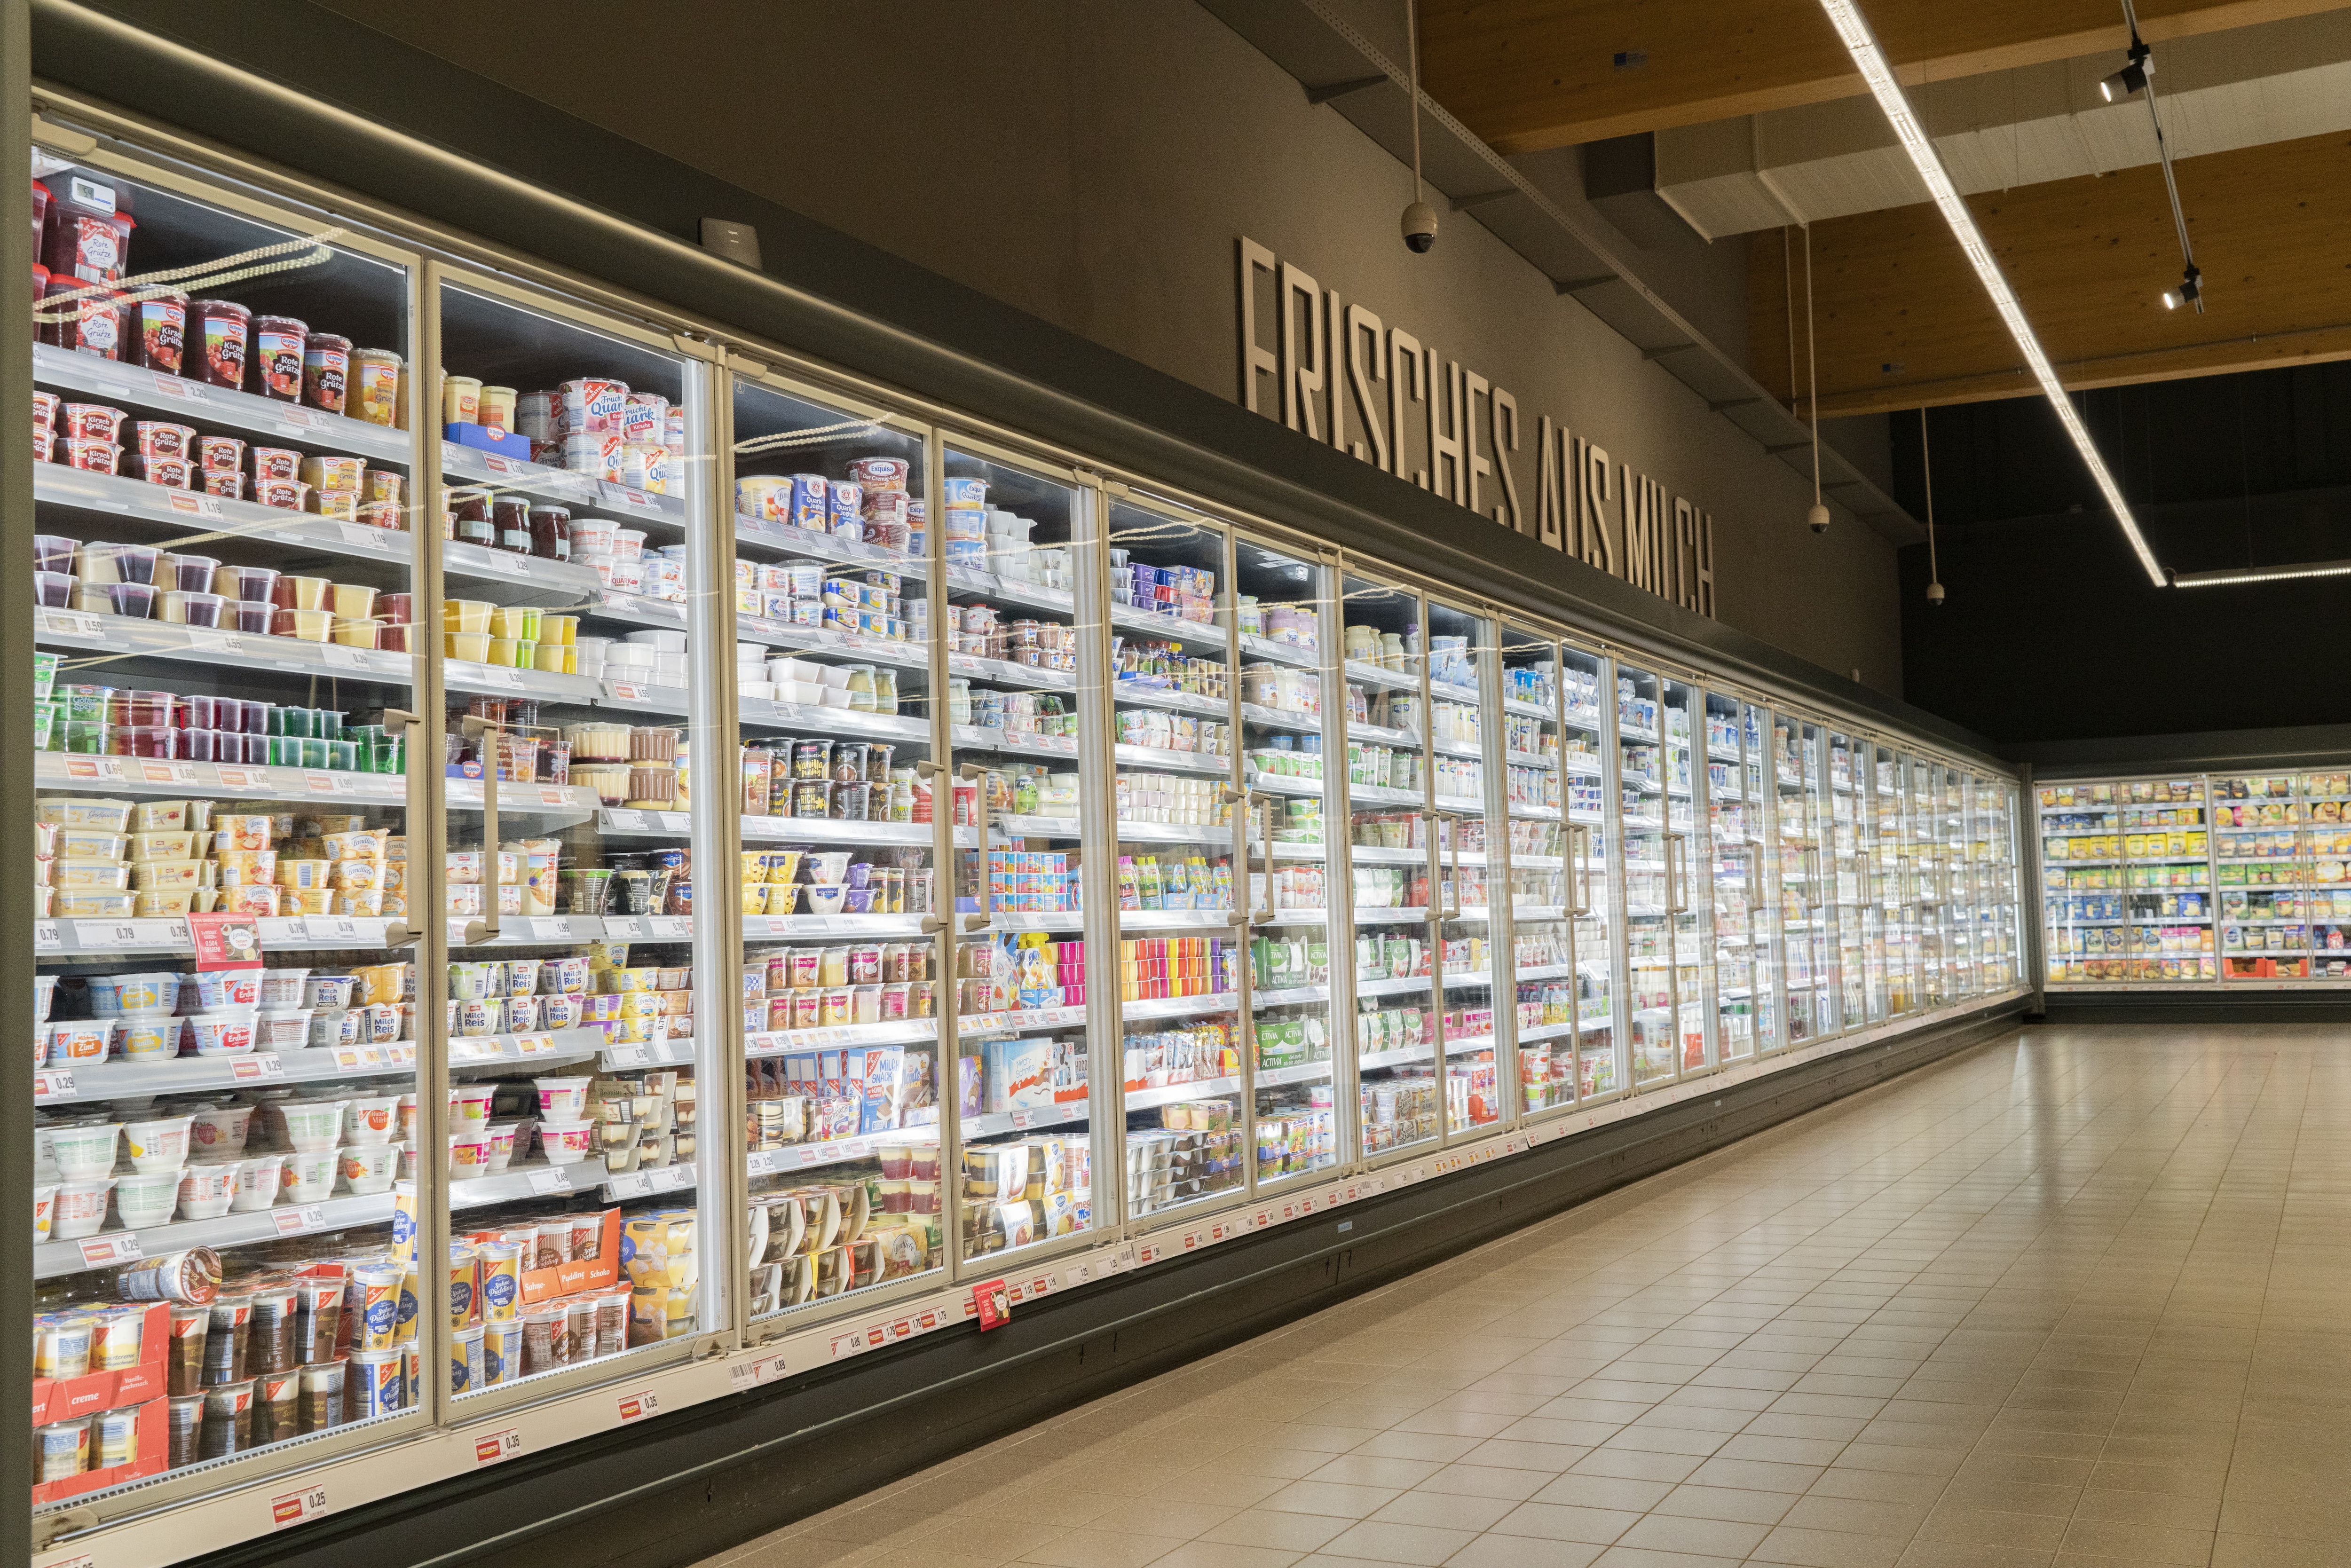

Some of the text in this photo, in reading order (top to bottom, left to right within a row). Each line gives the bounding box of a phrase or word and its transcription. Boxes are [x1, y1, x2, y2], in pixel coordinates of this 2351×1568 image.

[162, 326, 183, 340] Kirsch
[160, 335, 183, 349] Grütze
[224, 342, 245, 353] Kirsch
[222, 350, 245, 362] Grütze
[281, 356, 298, 366] Rote
[275, 363, 300, 374] Grütze
[326, 372, 342, 382] Rote
[320, 379, 345, 390] Grütze
[190, 387, 206, 399] 2.29
[601, 395, 622, 404] Frucht
[1243, 236, 1522, 533] FRISCHES
[1539, 416, 1613, 574] AUS
[88, 416, 110, 425] Kirsch
[86, 422, 110, 432] Grütze
[160, 432, 175, 441] Rote
[155, 439, 179, 448] Grütze
[89, 450, 110, 459] Kirsch
[213, 453, 235, 462] Grütze
[87, 456, 110, 465] Grütze
[271, 464, 292, 473] Grütze
[511, 463, 523, 474] 1.19
[162, 472, 183, 481] Grütze
[272, 494, 295, 502] Grütze
[648, 496, 659, 505] 0.99
[205, 502, 221, 514] 1.19
[810, 503, 825, 512] Joghurt
[372, 533, 386, 544] 1.19
[516, 560, 528, 570] 2.29
[85, 619, 103, 632] 0.59
[353, 654, 367, 664] 0.39
[509, 673, 522, 683] 0.39
[638, 689, 649, 698] 0.55
[105, 763, 122, 775] 0.69
[179, 768, 196, 779] 0.69
[253, 773, 268, 784] 0.99
[338, 778, 353, 788] 0.99
[564, 792, 576, 802] 0.39
[801, 795, 815, 804] RICH
[634, 815, 646, 824] 1.39
[347, 866, 372, 876] Landliebe
[170, 926, 188, 937] 0.79
[289, 923, 303, 933] 0.79
[338, 922, 353, 931] 0.79
[557, 923, 569, 932] 1.99
[629, 922, 640, 931] 0.79
[673, 922, 683, 931] 0.79
[40, 929, 59, 940] 0.79
[117, 928, 134, 939] 0.79
[513, 979, 530, 988] Reis
[1272, 975, 1287, 984] ACTIVIA
[465, 1018, 485, 1027] Reis
[657, 1016, 666, 1030] 0.79
[375, 1025, 394, 1033] Reis
[1285, 1030, 1302, 1038] ACTIVIA
[79, 1042, 94, 1051] Zimt
[747, 1040, 757, 1048] 0.79
[636, 1049, 647, 1059] 0.79
[266, 1060, 282, 1072] 0.29
[1016, 1057, 1032, 1067] Milch-
[1262, 1058, 1282, 1067] ACTIVIA
[1016, 1064, 1035, 1078] Schnitte
[55, 1077, 75, 1089] 0.29
[872, 1074, 892, 1083] SNACK
[750, 1158, 760, 1167] 2.29
[764, 1157, 773, 1165] 2.29
[557, 1173, 568, 1183] 0.49
[673, 1173, 684, 1182] 1.49
[637, 1178, 648, 1189] 1.49
[308, 1210, 323, 1222] 0.29
[121, 1239, 140, 1252] 0.29
[562, 1271, 584, 1282] Pudding
[590, 1269, 610, 1278] Schoko
[494, 1280, 510, 1289] Sahne
[525, 1283, 545, 1292] Sahne-
[488, 1284, 513, 1296] Pudding
[370, 1310, 394, 1324] Pudding
[913, 1318, 921, 1328] 1.79
[851, 1337, 860, 1348] 0.89
[775, 1360, 785, 1371] 0.89
[119, 1380, 148, 1393] geschmack
[71, 1393, 99, 1405] creme
[645, 1396, 657, 1409] 0.35
[506, 1435, 520, 1450] 0.35
[309, 1492, 326, 1507] 0.25
